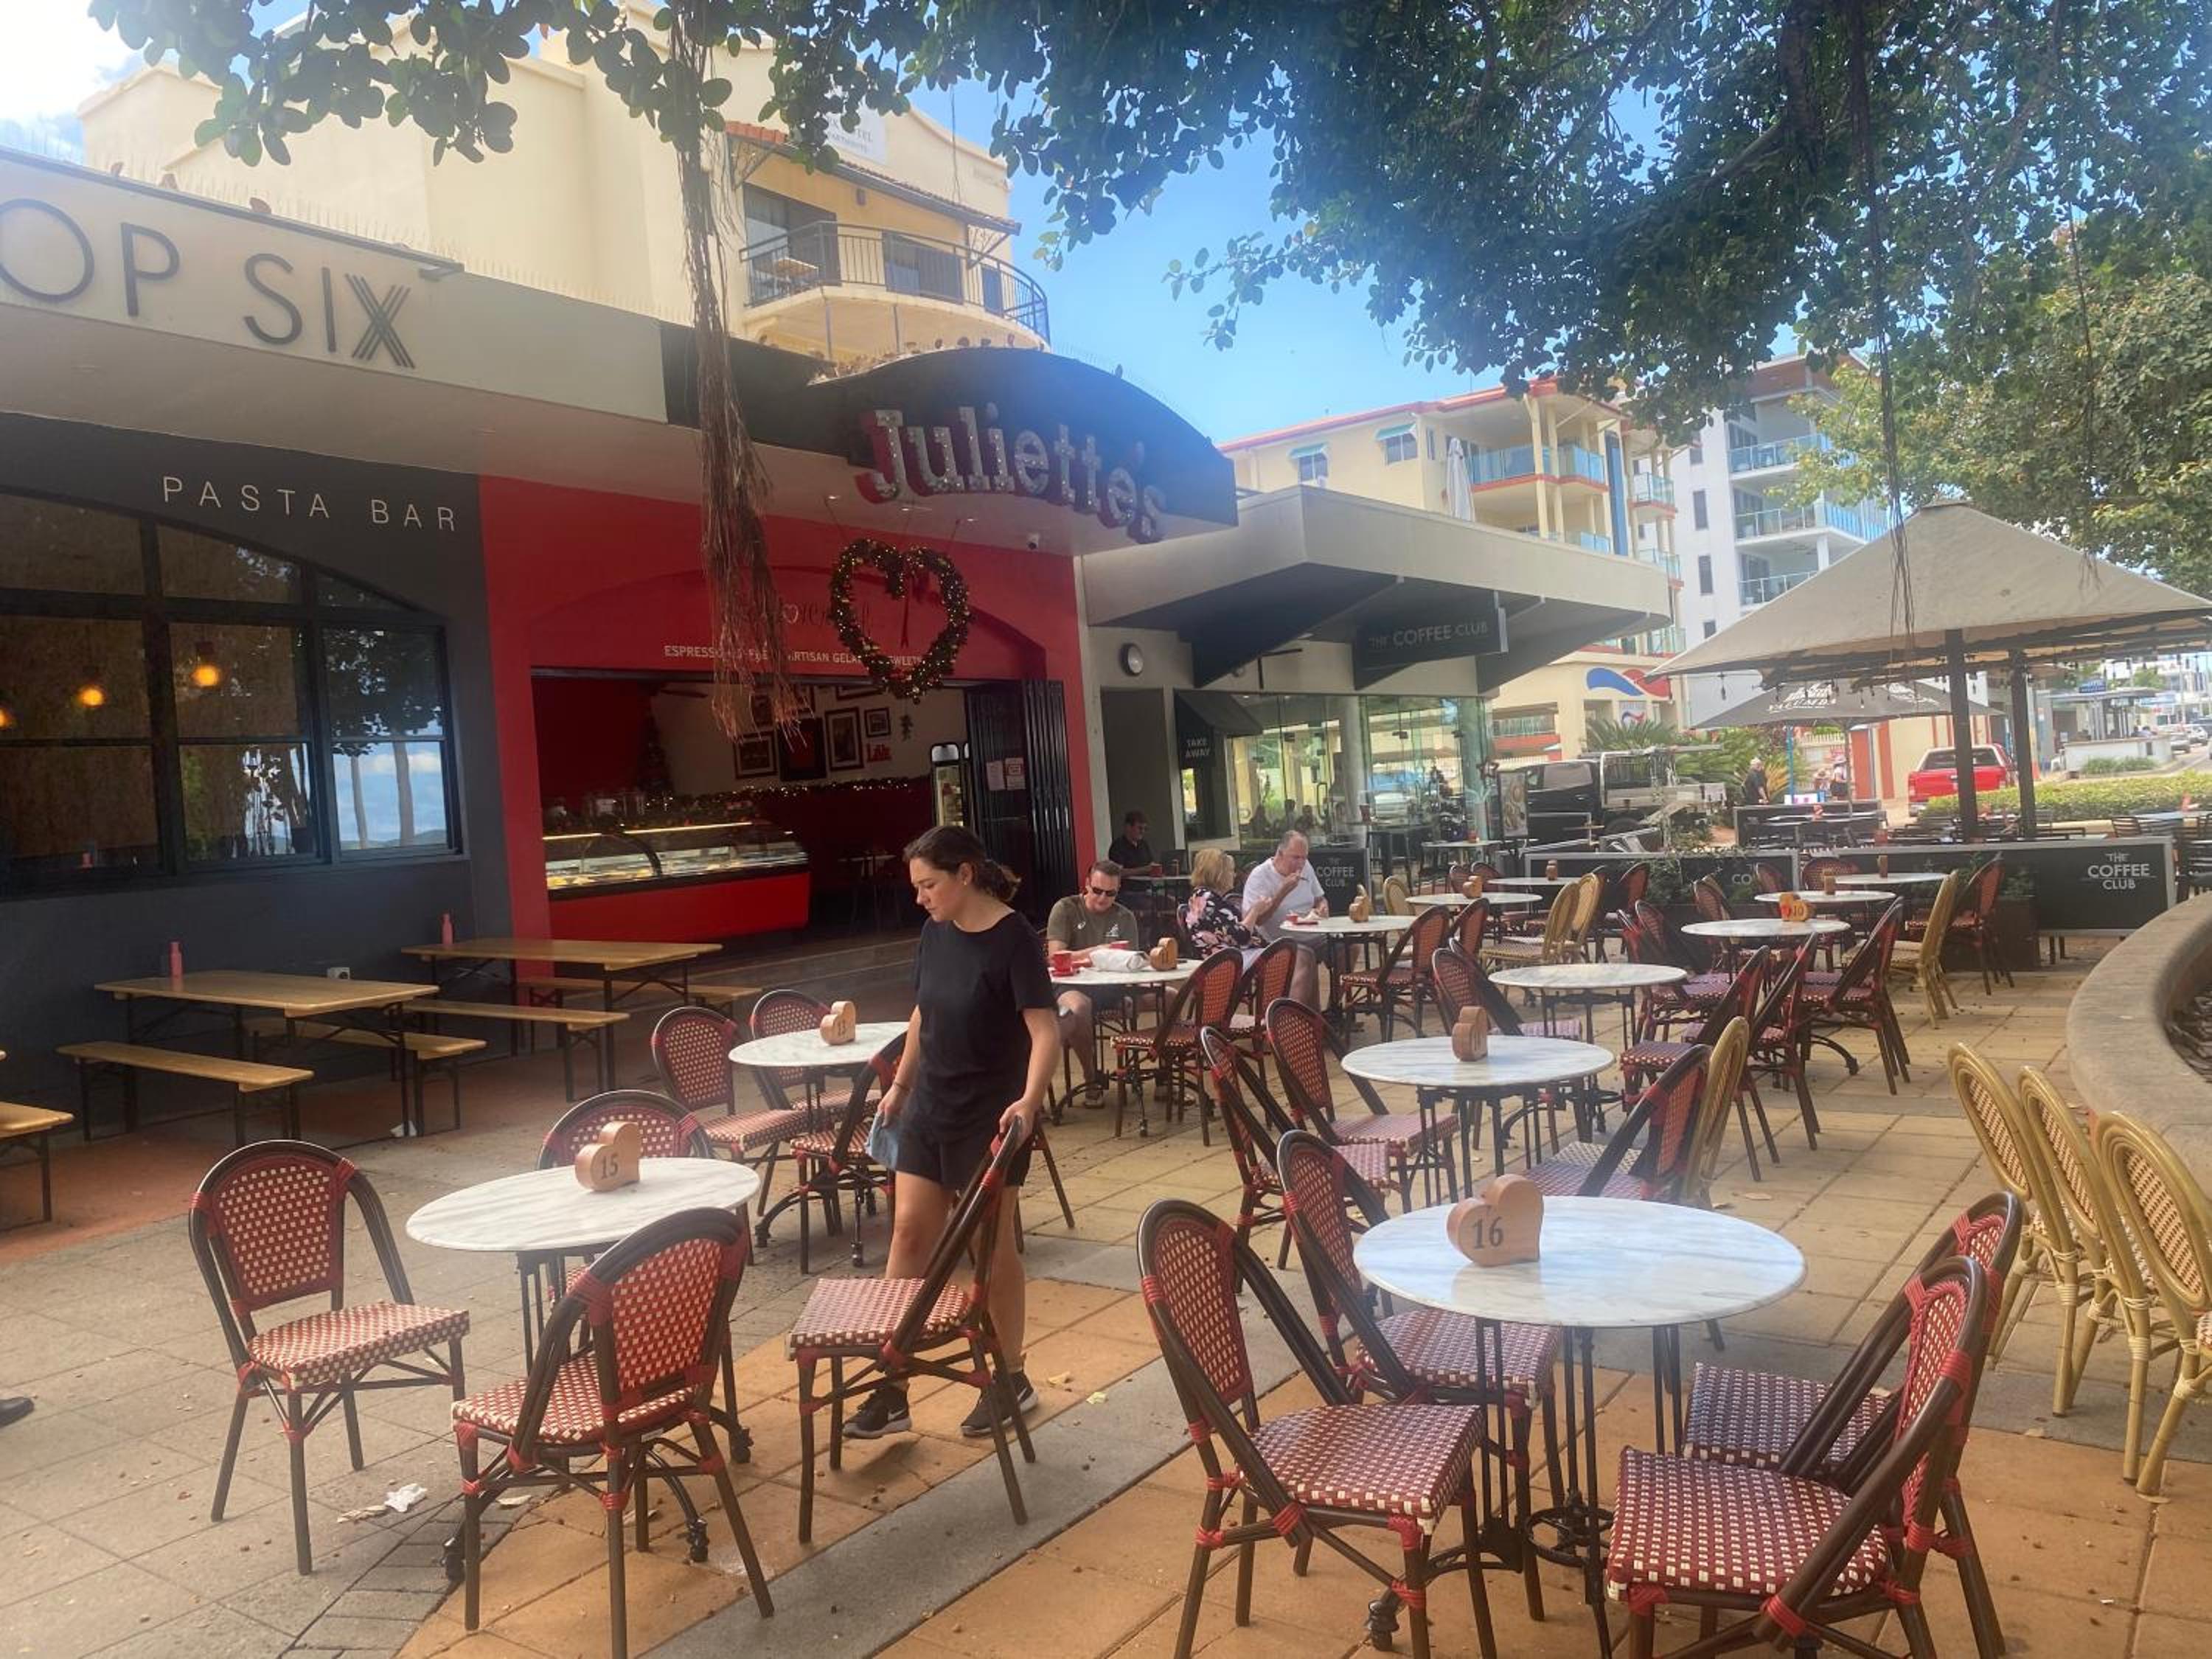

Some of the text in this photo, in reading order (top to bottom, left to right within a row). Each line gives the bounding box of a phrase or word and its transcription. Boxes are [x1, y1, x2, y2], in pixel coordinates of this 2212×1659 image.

[244, 253, 415, 369] SIX
[860, 403, 1166, 543] Juliette's
[162, 476, 455, 531] PASTA BAR
[1392, 625, 1452, 645] COFFEE
[1455, 621, 1488, 637] CLUB
[1185, 748, 1211, 758] AWAY
[2105, 852, 2130, 862] THE
[1316, 866, 1354, 877] COFFEE
[2087, 863, 2150, 878] COFFEE
[2102, 879, 2136, 890] CLUB
[601, 1152, 619, 1180] 15
[1472, 1215, 1504, 1250] 16
